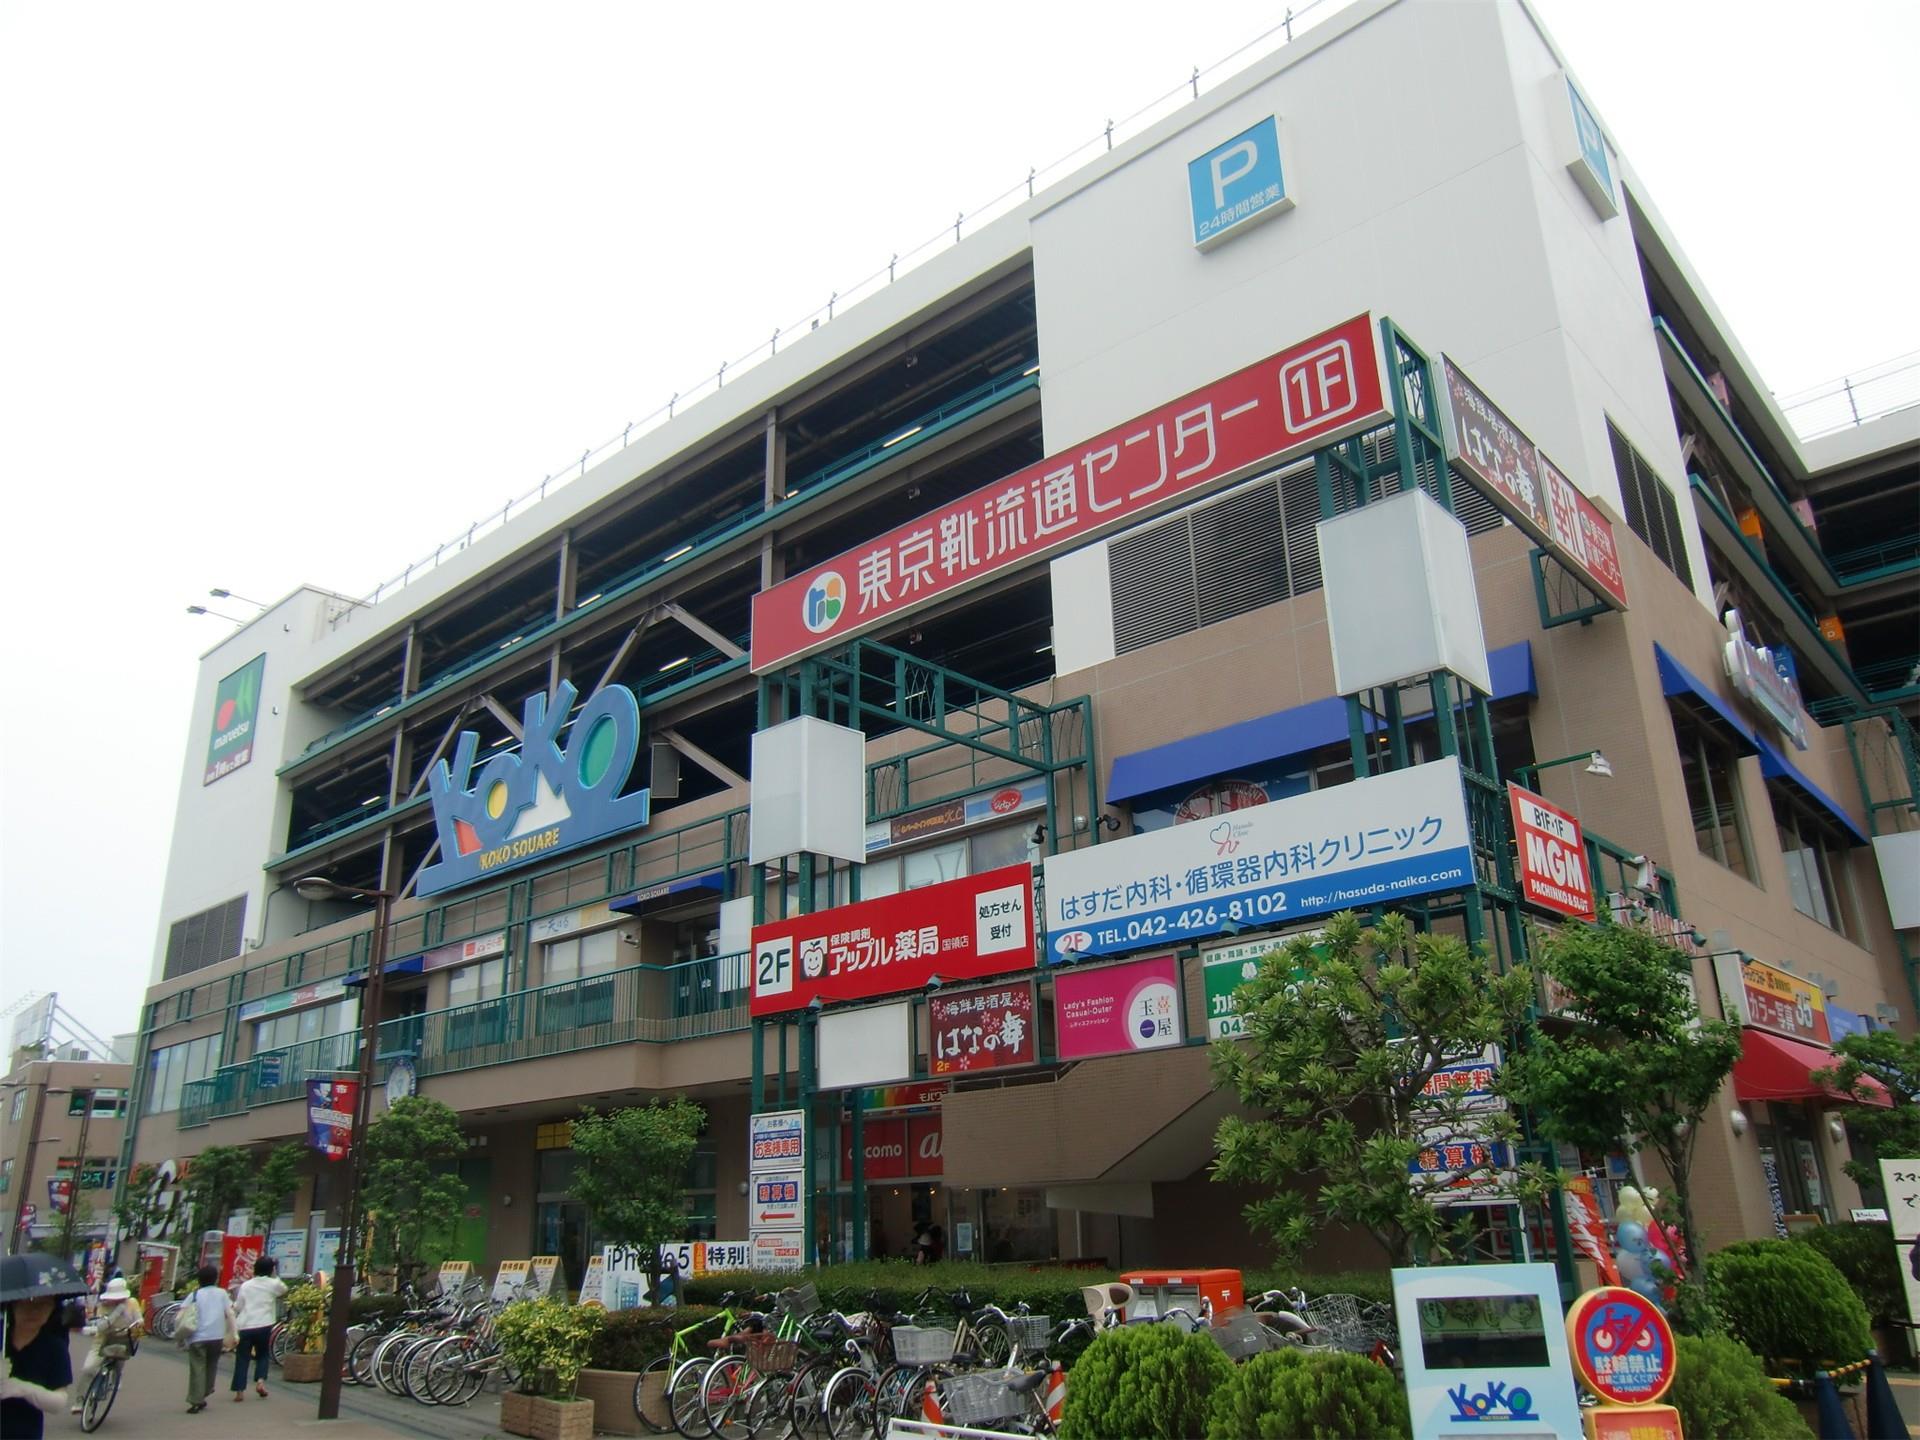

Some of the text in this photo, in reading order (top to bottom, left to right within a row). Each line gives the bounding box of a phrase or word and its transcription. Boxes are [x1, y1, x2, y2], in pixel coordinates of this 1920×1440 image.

[1211, 140, 1258, 210] P
[1199, 184, 1281, 235] 24時間営業
[1291, 353, 1342, 419] 1F
[856, 399, 1260, 615] 東京靴流通センター
[213, 720, 250, 751] maruetsu
[479, 828, 560, 870] KOKO SQUARE
[1060, 816, 1443, 921] はすだ内科・循環器内科クリニック
[1525, 831, 1586, 893] MGM
[651, 882, 671, 898] SQUARE
[1300, 867, 1462, 909] http://hasuda-naika.com
[978, 898, 1022, 920] 処方せん
[830, 926, 872, 947] 保険調剤
[830, 925, 970, 977] アップル薬局 国領店
[990, 923, 1012, 941] 受付
[758, 947, 792, 986] 2F
[946, 991, 1014, 1017] 海鮮居酒屋
[1063, 995, 1115, 1012] Lady's Fashion
[1749, 992, 1796, 1032] カラー写真
[937, 1010, 1027, 1060] はなの舞
[936, 1061, 950, 1073] 2F
[754, 1137, 800, 1159] お客様専用
[758, 1183, 796, 1201] 精算機
[1594, 1353, 1663, 1374] 駐輪禁止
